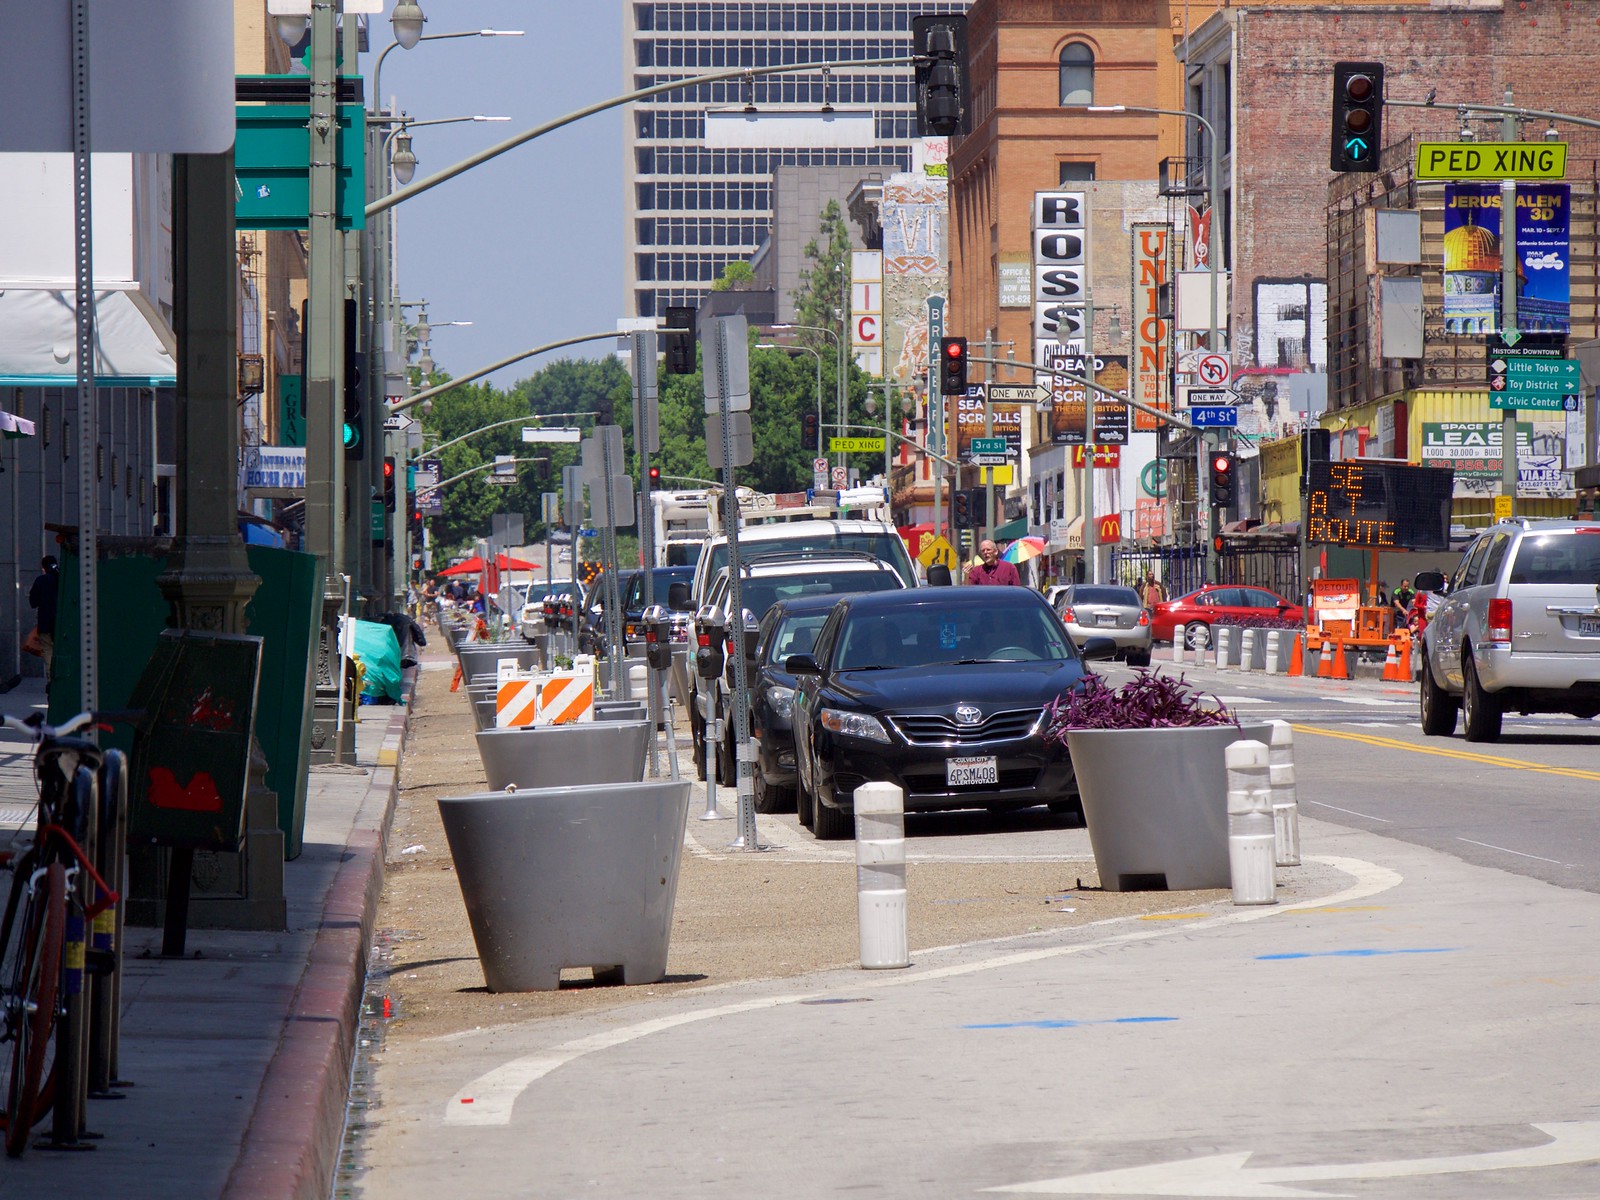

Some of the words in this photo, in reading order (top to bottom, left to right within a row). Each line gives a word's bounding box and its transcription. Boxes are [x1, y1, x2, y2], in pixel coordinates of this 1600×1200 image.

[1430, 150, 1481, 171] PED
[1494, 150, 1554, 172] XING
[1530, 208, 1555, 221] 3D
[1041, 197, 1082, 333] ROSS
[1139, 231, 1167, 372] UNION
[1053, 359, 1105, 371] DEAD
[1509, 362, 1532, 373] Little
[1535, 363, 1560, 374] Tokyo
[1509, 379, 1524, 390] Toy
[1526, 380, 1559, 390] District
[991, 389, 1010, 398] ONE
[1017, 389, 1036, 398] WAY
[958, 400, 984, 410] SEA
[1508, 396, 1529, 406] Civic
[1531, 397, 1560, 407] Center
[1196, 411, 1216, 423] 4th
[1218, 411, 1231, 422] St
[834, 440, 855, 449] PED
[858, 440, 881, 449] XING
[1428, 432, 1528, 446] LEASE
[975, 441, 991, 450] 3rd
[993, 441, 1003, 450] St
[1484, 448, 1502, 457] BUILT
[247, 470, 280, 486] HOUSE
[282, 471, 295, 486] OF
[1520, 470, 1562, 481] VIAJES
[1311, 490, 1328, 516] A
[1346, 492, 1362, 516] T
[1309, 517, 1395, 545] ROUTE
[1317, 583, 1355, 591] DETOUR
[950, 766, 996, 781] 6PSM408
